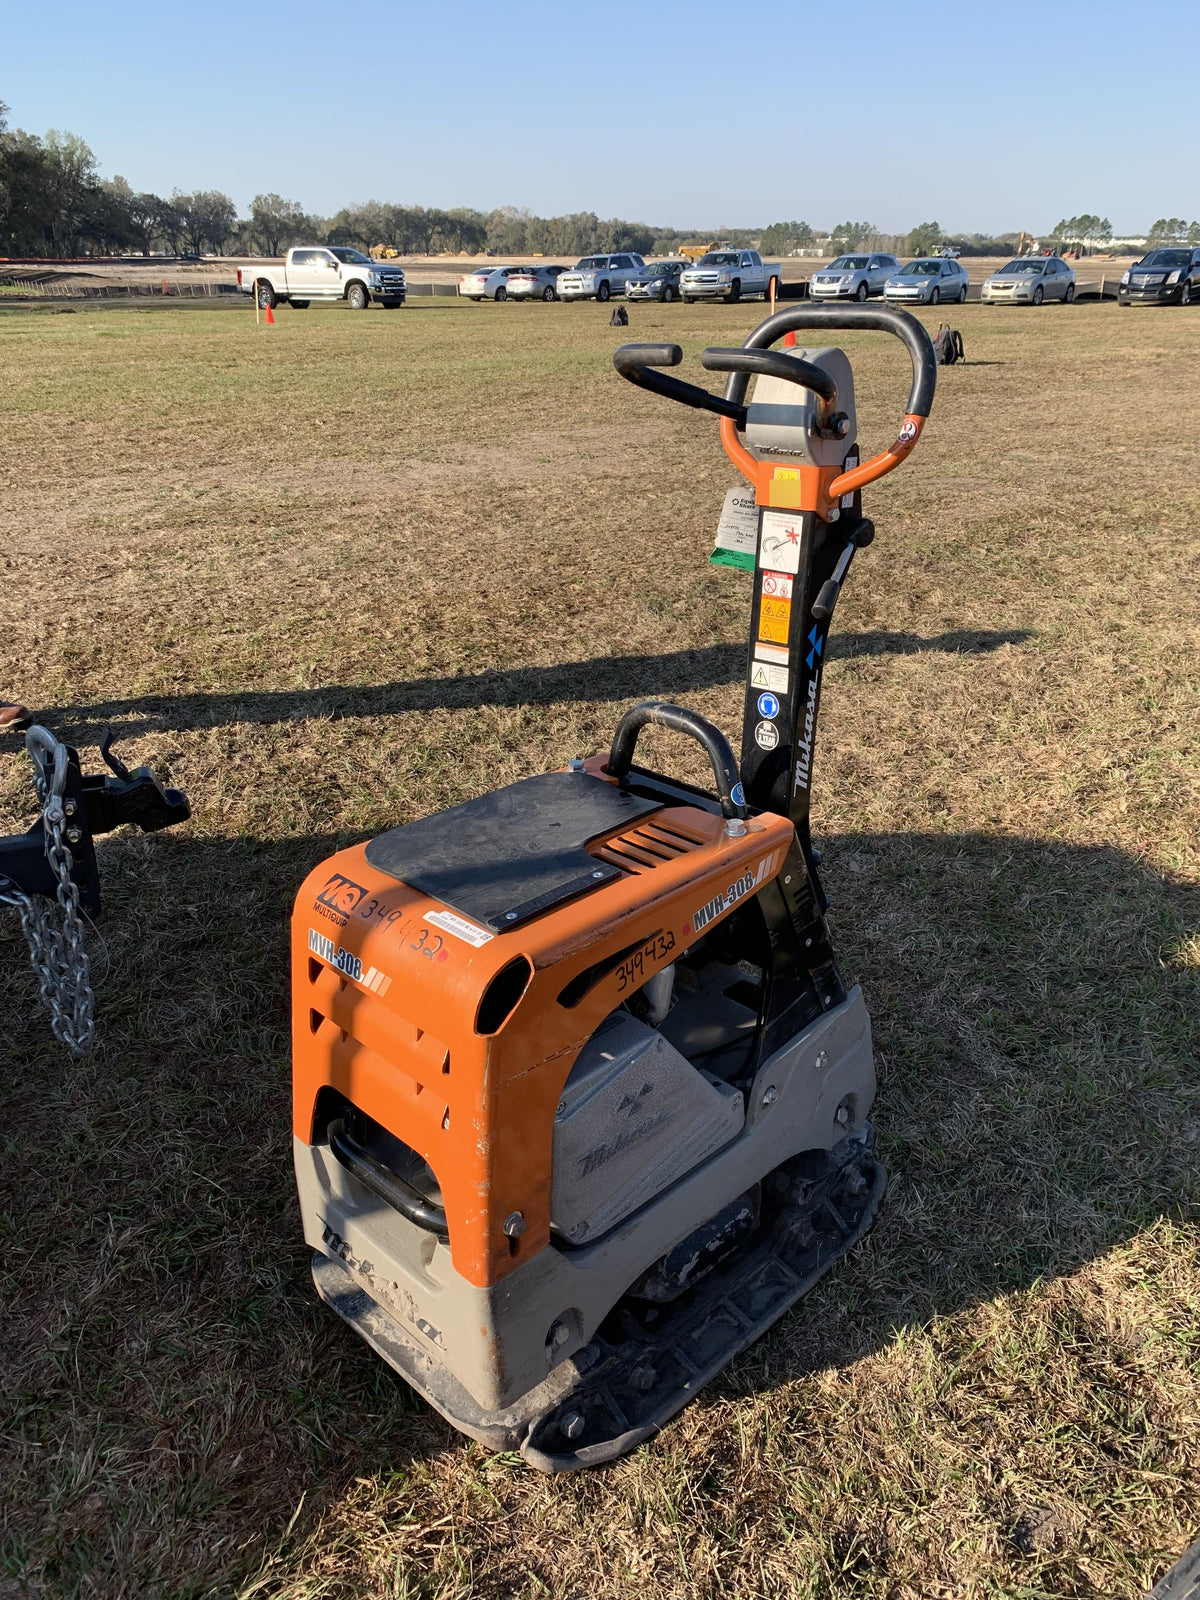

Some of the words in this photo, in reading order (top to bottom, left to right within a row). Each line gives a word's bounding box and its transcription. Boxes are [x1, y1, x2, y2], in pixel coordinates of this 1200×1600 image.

[793, 670, 818, 798] Mikasa
[313, 902, 348, 928] MULTIQUIP
[318, 877, 363, 918] MQ
[693, 872, 754, 932] MVH-308
[308, 928, 363, 981] MVH-308
